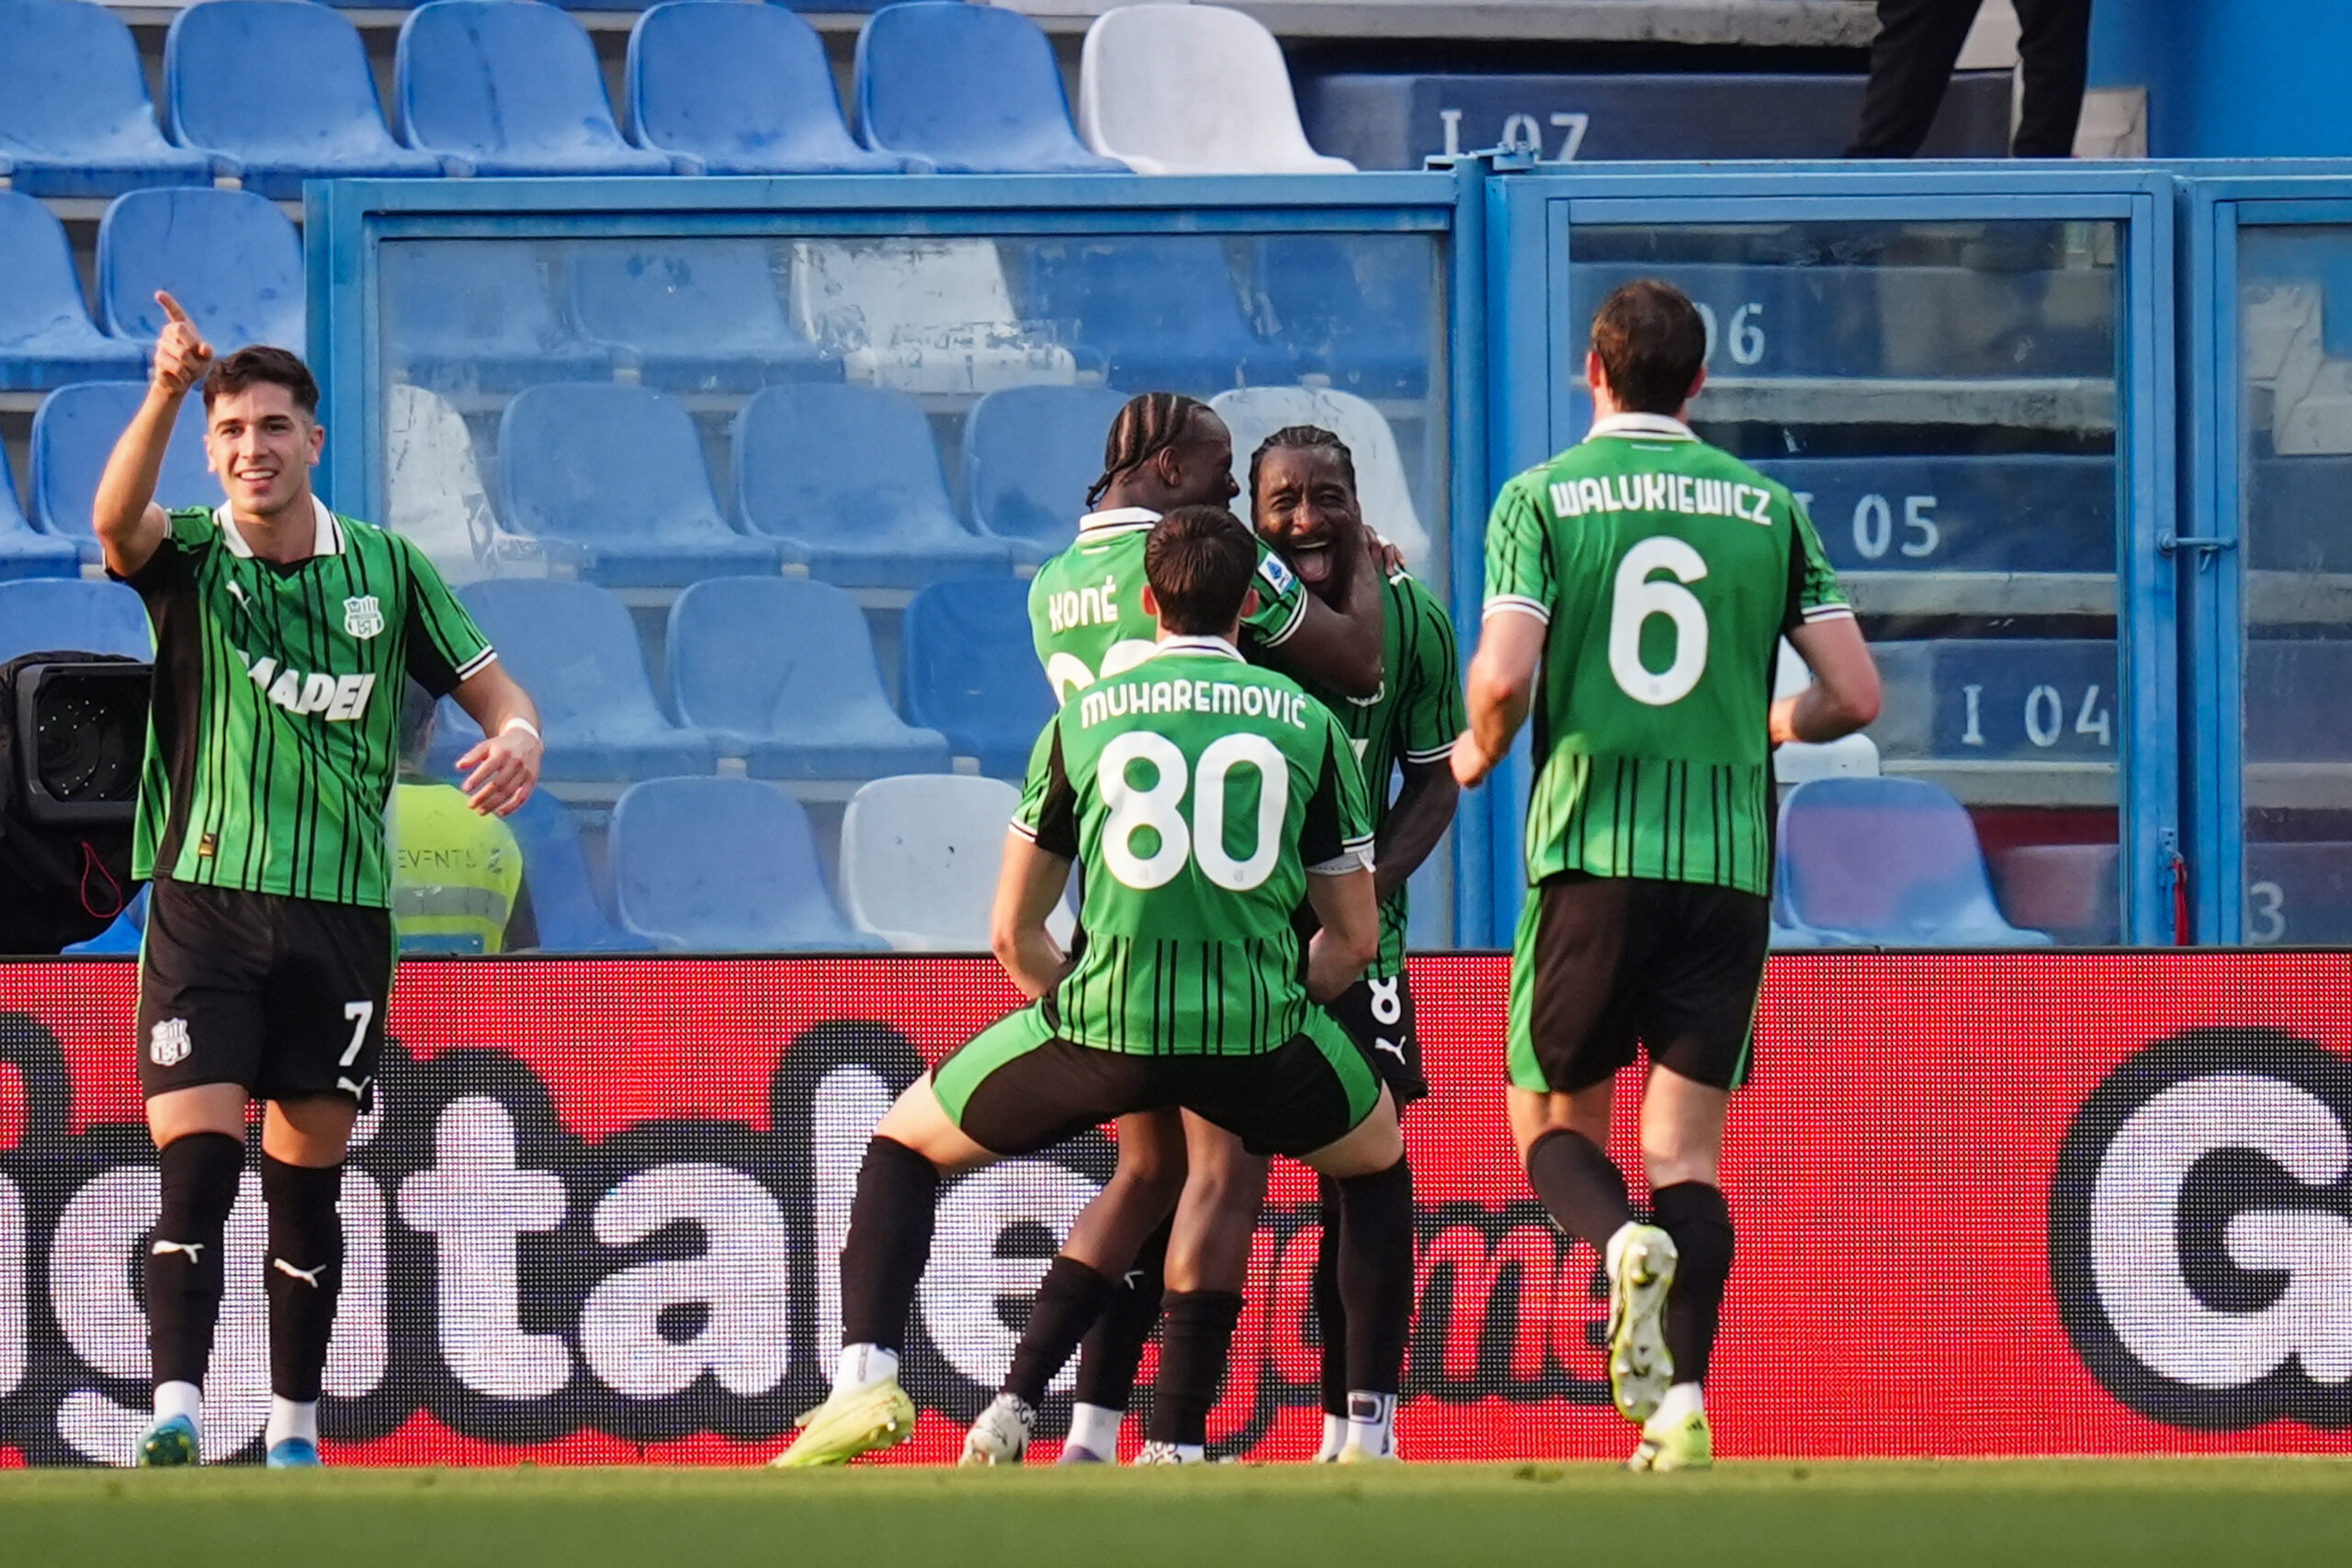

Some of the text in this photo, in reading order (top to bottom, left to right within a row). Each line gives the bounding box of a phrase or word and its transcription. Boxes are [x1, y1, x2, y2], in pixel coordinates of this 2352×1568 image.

[1501, 111, 1590, 162] 07
[1549, 472, 1772, 526] WALUKIEWICZ
[1852, 493, 1939, 558] 05
[1048, 574, 1118, 633] KONÉ
[1608, 535, 1709, 706] 6
[1080, 678, 1306, 729] MUHAREMOVIĆ
[2025, 683, 2110, 748] 04
[1097, 730, 1289, 892] 80
[398, 848, 476, 869] EVENTS
[1367, 975, 1401, 1025] 8
[338, 999, 374, 1066] 7
